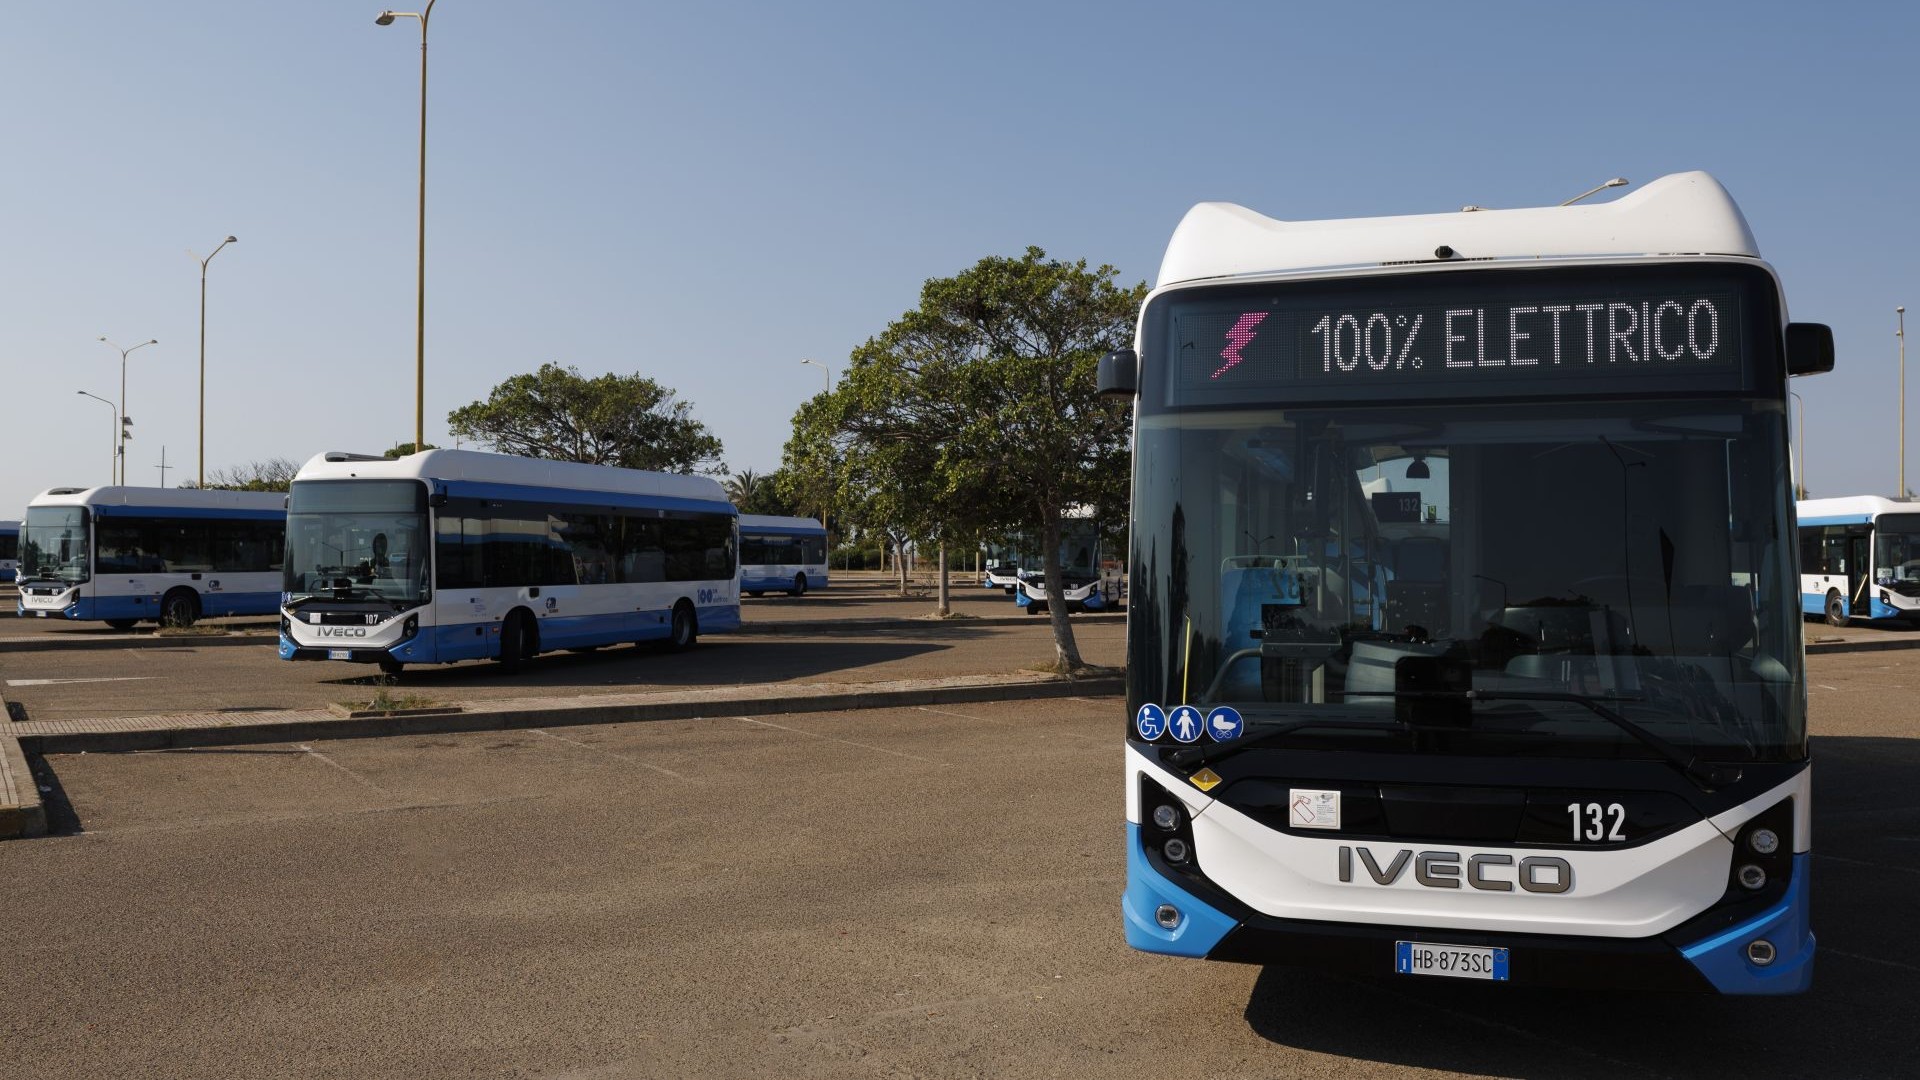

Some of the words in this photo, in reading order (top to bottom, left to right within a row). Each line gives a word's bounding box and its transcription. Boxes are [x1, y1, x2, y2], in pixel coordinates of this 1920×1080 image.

[1311, 313, 1424, 372] 100%
[1445, 299, 1719, 368] ELETTRICO
[1399, 498, 1419, 512] 132
[316, 626, 367, 638] IVECO
[364, 614, 379, 625] 107
[1567, 803, 1626, 842] 132
[1338, 846, 1572, 894] IVECO
